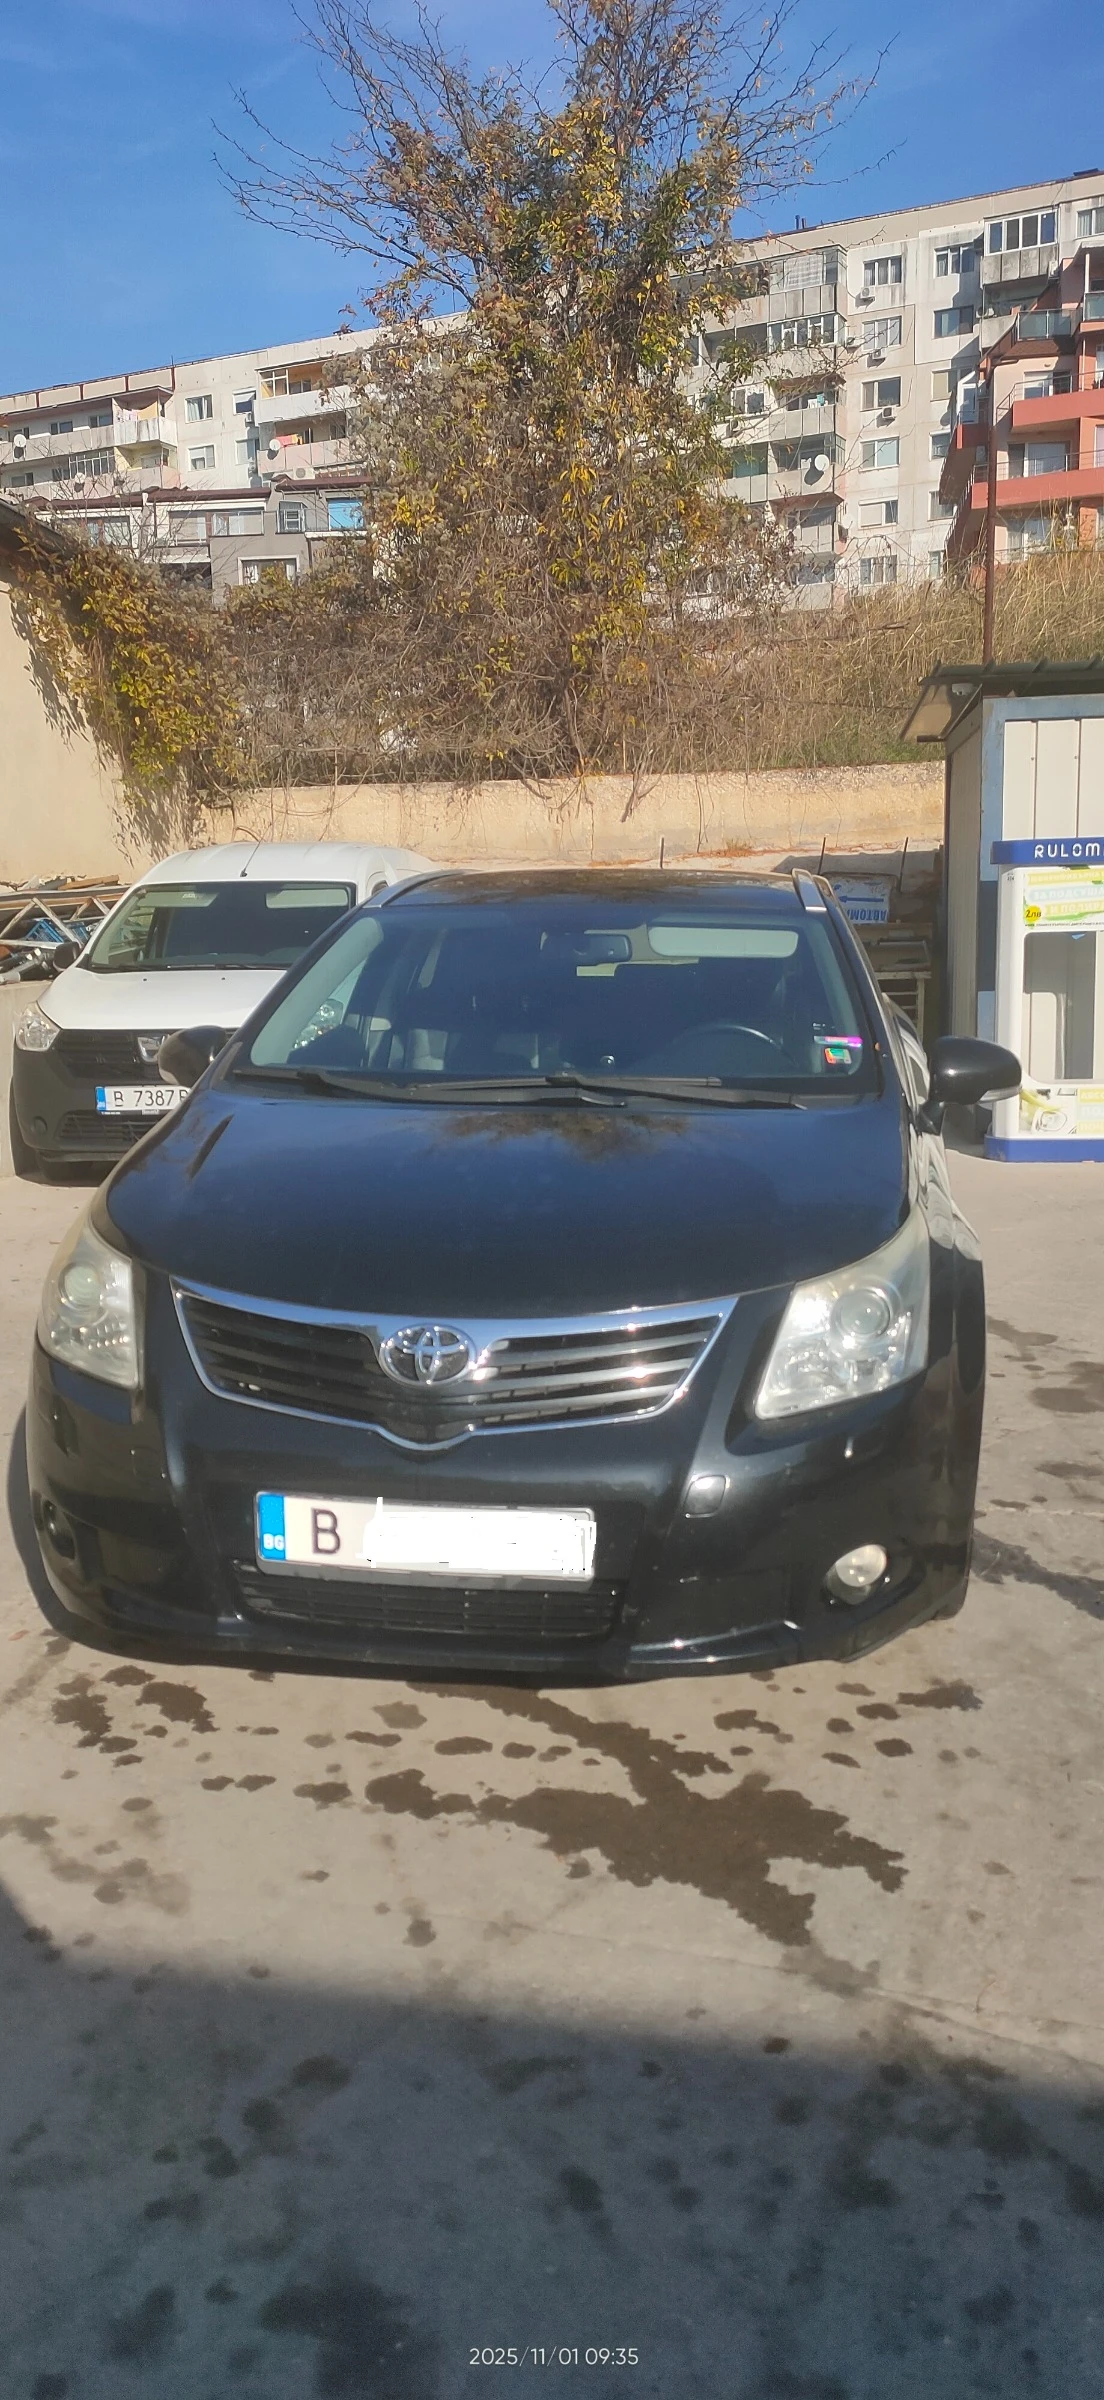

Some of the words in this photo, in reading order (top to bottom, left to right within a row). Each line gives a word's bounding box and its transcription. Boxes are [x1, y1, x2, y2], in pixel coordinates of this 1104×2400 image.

[1034, 842, 1104, 858] RULOM
[113, 1090, 124, 1107] B
[133, 1089, 174, 1107] 7387
[311, 1508, 341, 1555] B
[263, 1533, 285, 1551] BG
